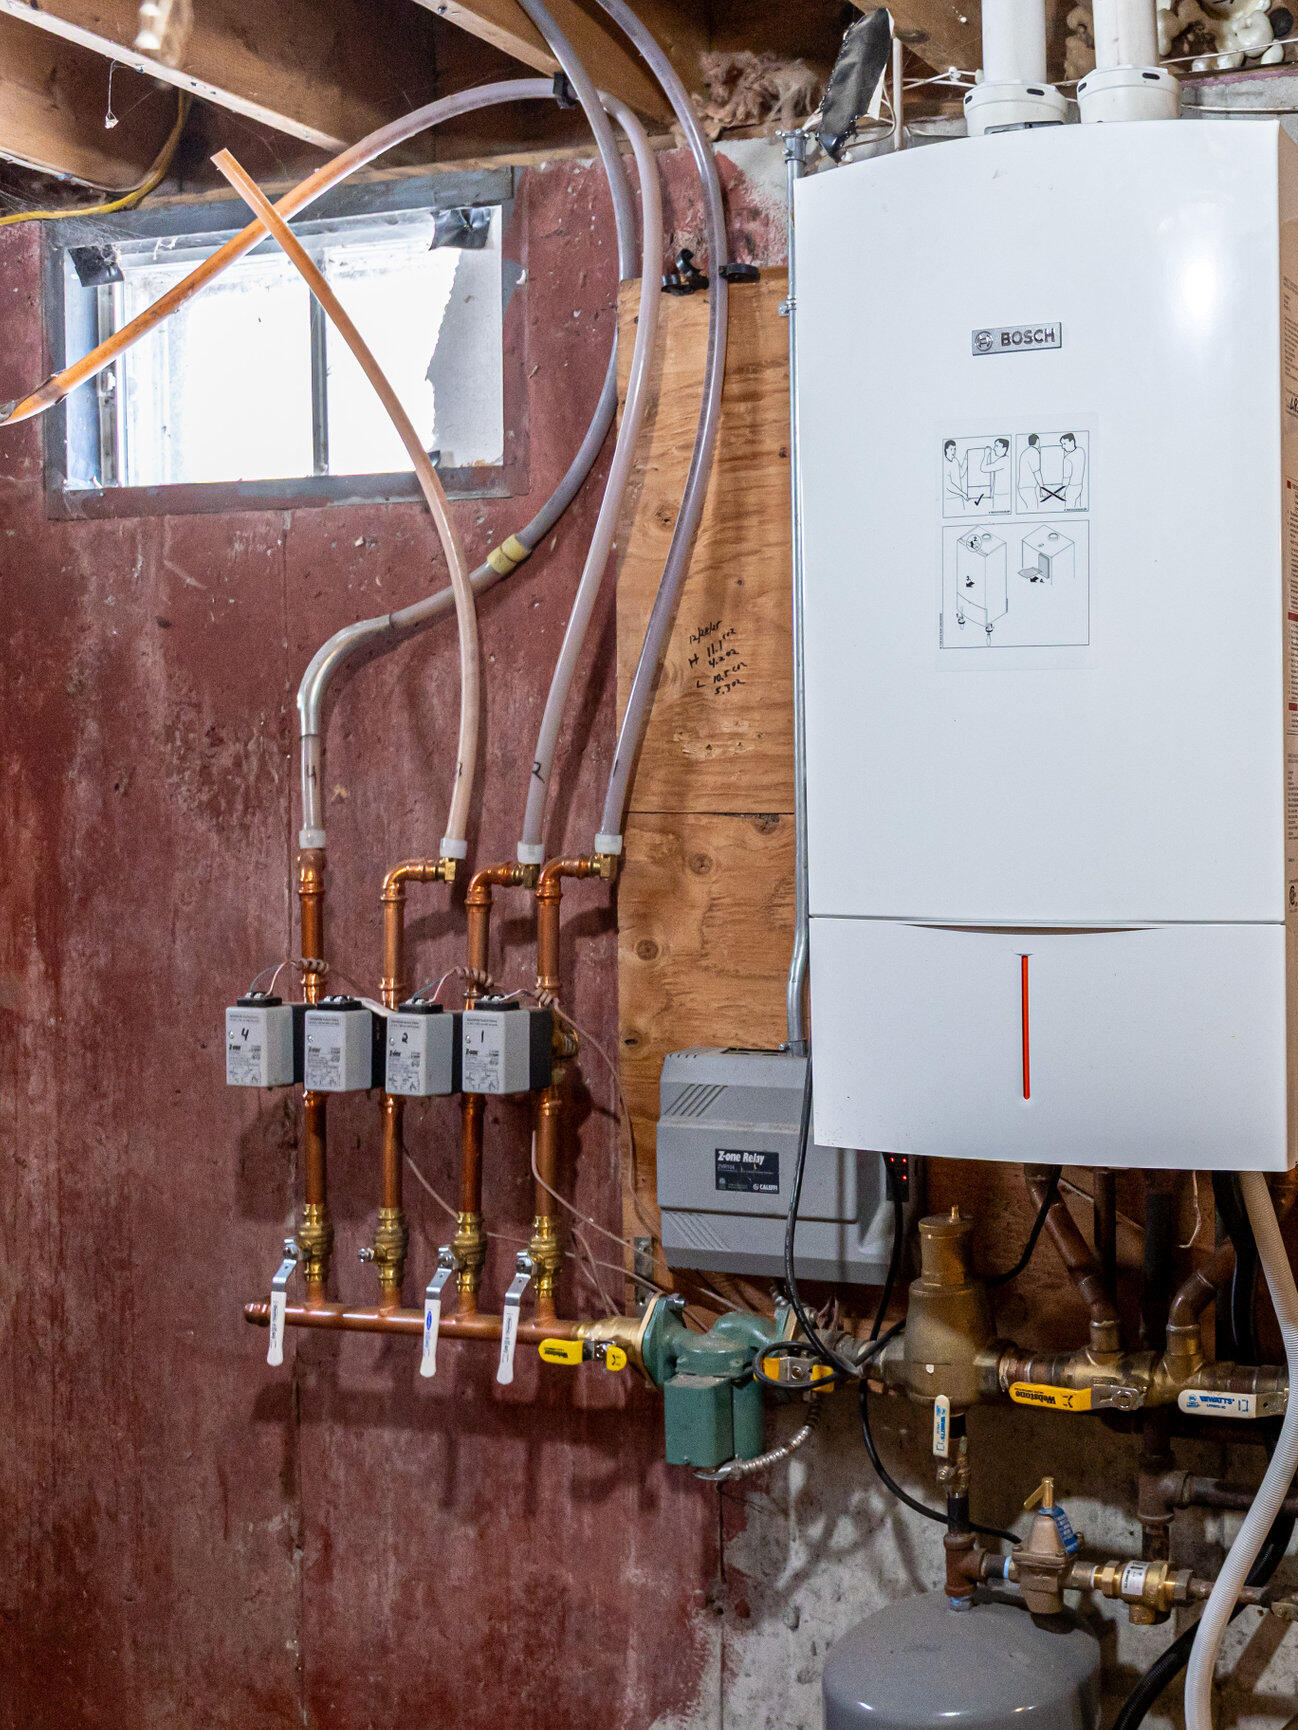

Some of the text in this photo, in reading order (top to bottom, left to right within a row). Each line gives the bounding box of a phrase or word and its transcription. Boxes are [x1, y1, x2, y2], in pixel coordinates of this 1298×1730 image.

[1001, 328, 1055, 346] BOSCH
[241, 1028, 250, 1041] 4
[717, 1151, 765, 1165] Z-one Relay
[1015, 1390, 1057, 1405] Webstone
[1199, 1395, 1234, 1405] WATTS
